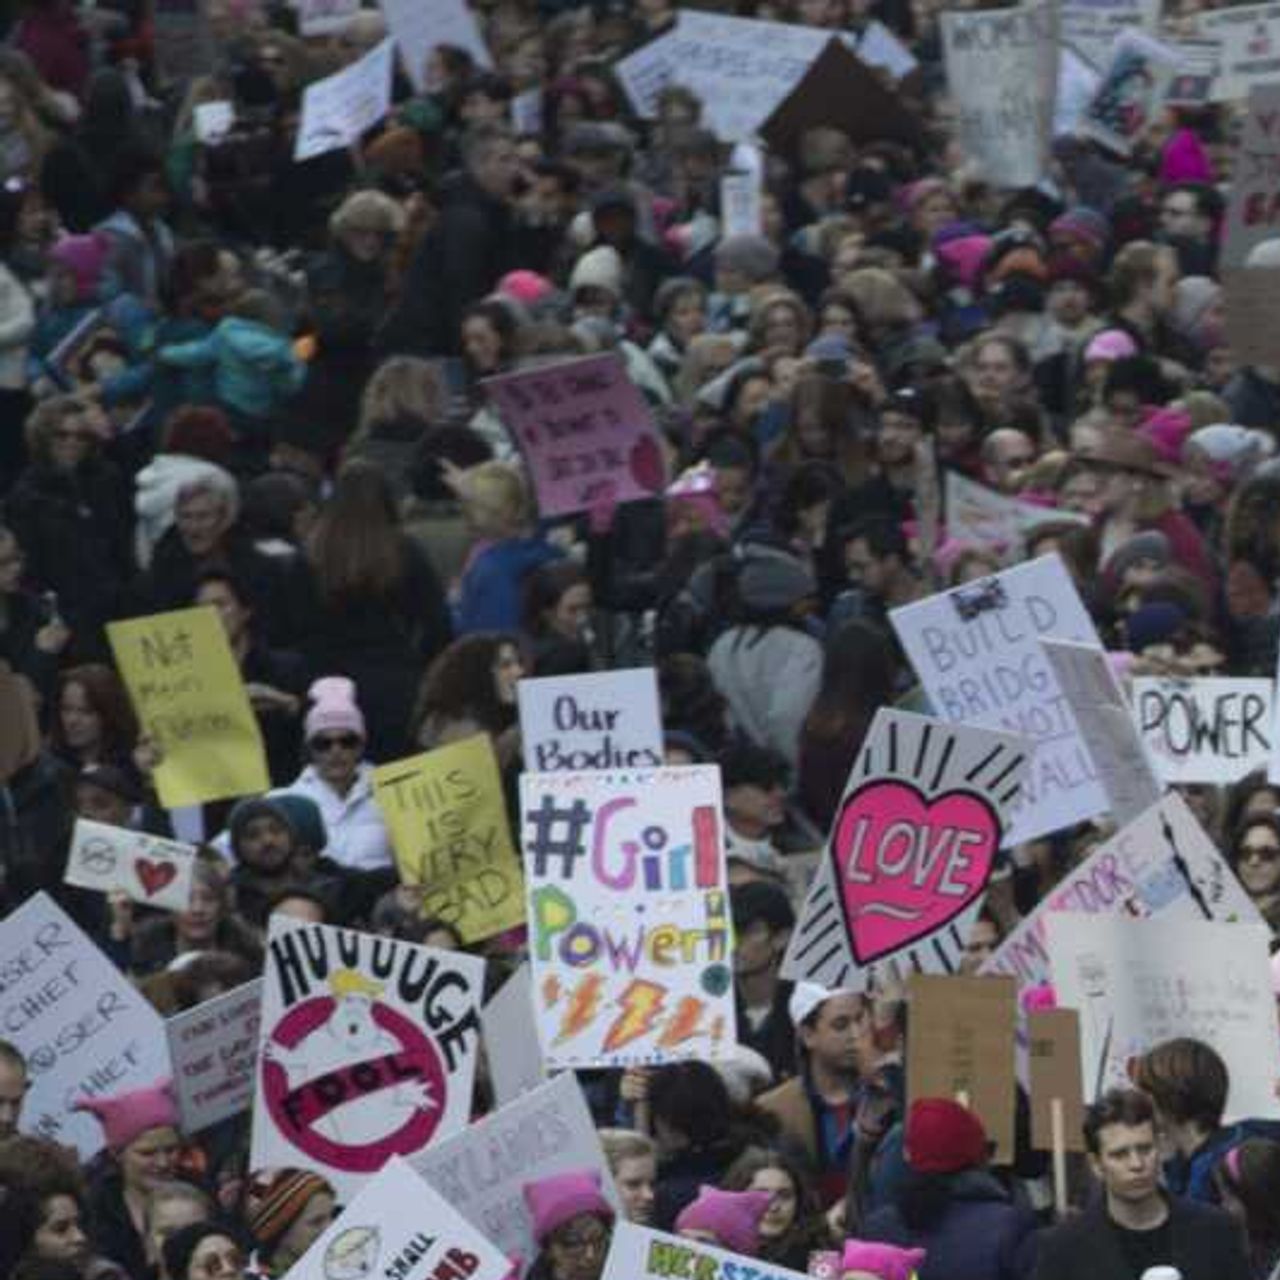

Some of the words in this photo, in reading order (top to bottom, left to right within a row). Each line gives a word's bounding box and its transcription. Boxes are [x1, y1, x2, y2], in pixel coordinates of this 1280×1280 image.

[920, 592, 1059, 673] BUILD
[552, 695, 623, 733] Our
[1139, 689, 1272, 758] POWER
[526, 795, 720, 892] #Girl
[846, 815, 982, 897] LOVE
